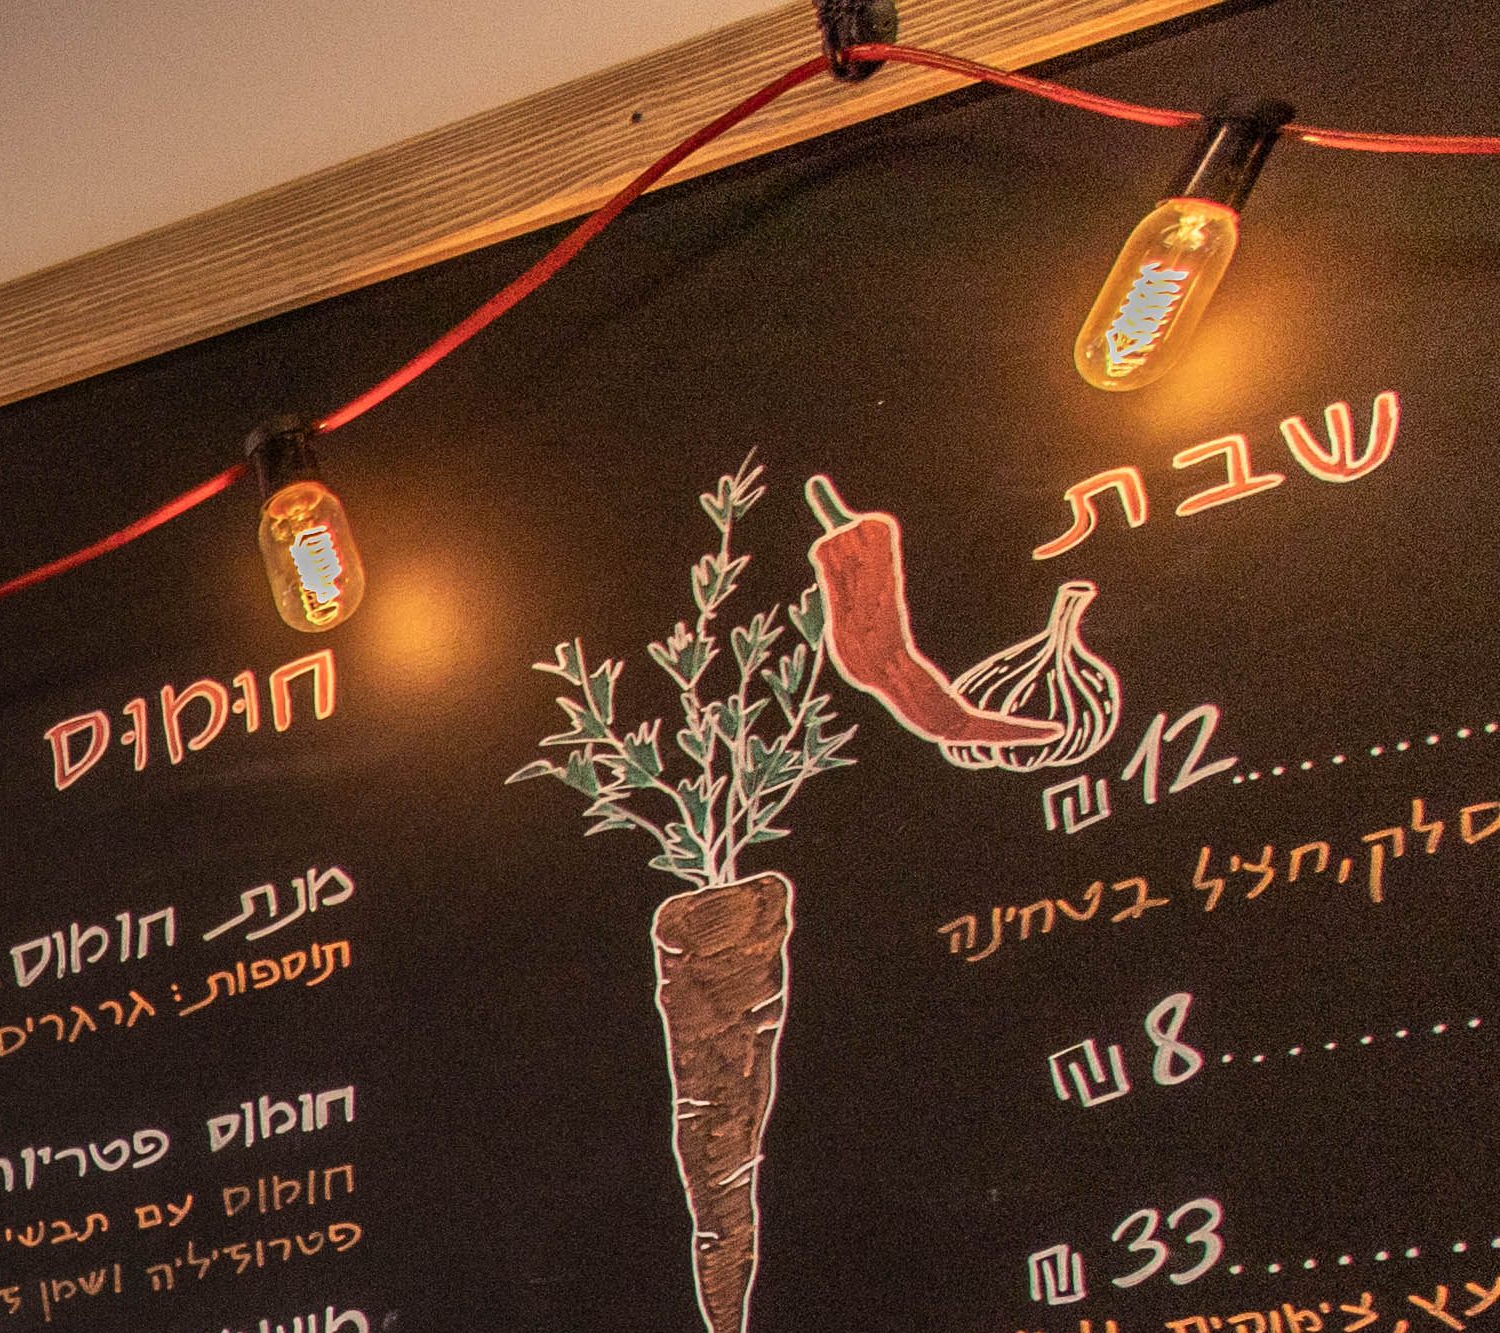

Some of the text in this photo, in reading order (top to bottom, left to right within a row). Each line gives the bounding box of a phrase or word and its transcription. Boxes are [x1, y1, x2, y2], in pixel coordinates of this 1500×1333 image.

[1032, 389, 1400, 560] שבת
[203, 866, 355, 944] מנת
[938, 841, 1331, 963] חציל בטחינה
[8, 905, 175, 991] חומוס
[207, 1085, 355, 1152] חומוס
[222, 1163, 355, 1217] חומוס
[40, 1263, 122, 1322] ושמן
[146, 1221, 363, 1291] פטרוזיליה
